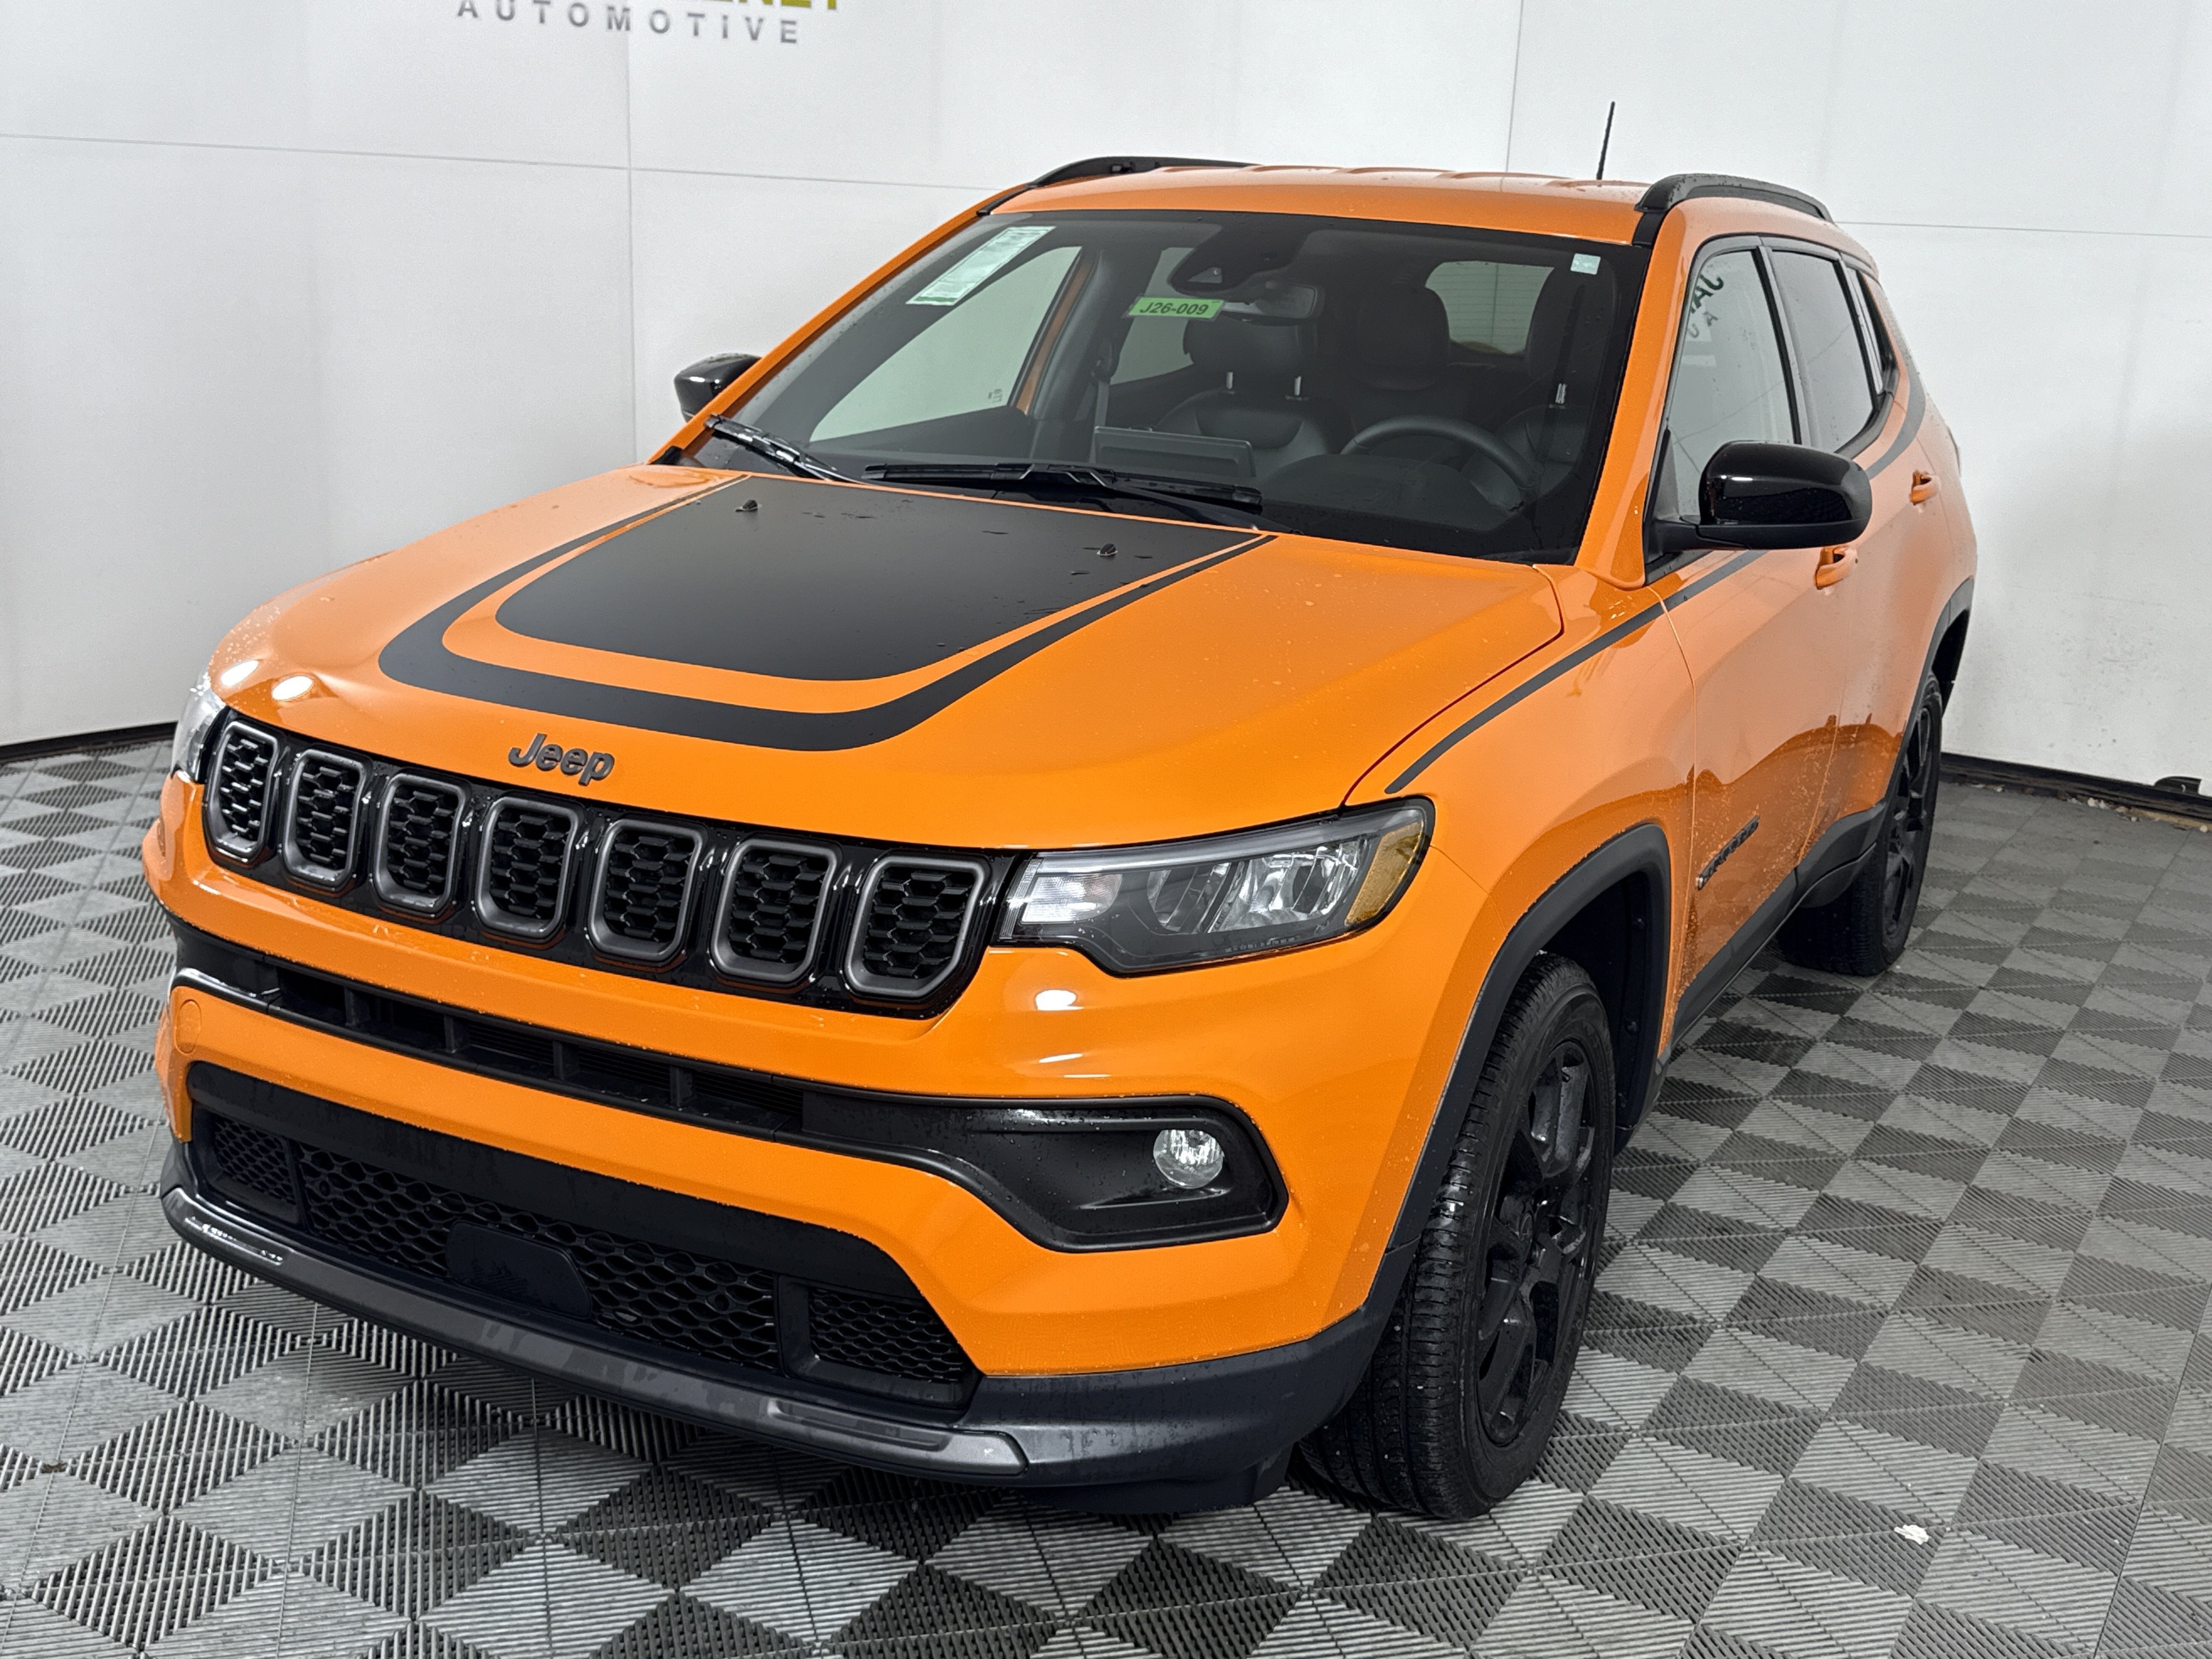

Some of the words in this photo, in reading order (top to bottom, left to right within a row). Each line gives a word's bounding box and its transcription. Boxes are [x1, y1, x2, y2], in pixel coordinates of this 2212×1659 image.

[458, 0, 798, 43] AUTOMOTIVE
[1139, 302, 1209, 315] J26-009
[509, 733, 614, 786] Jeep
